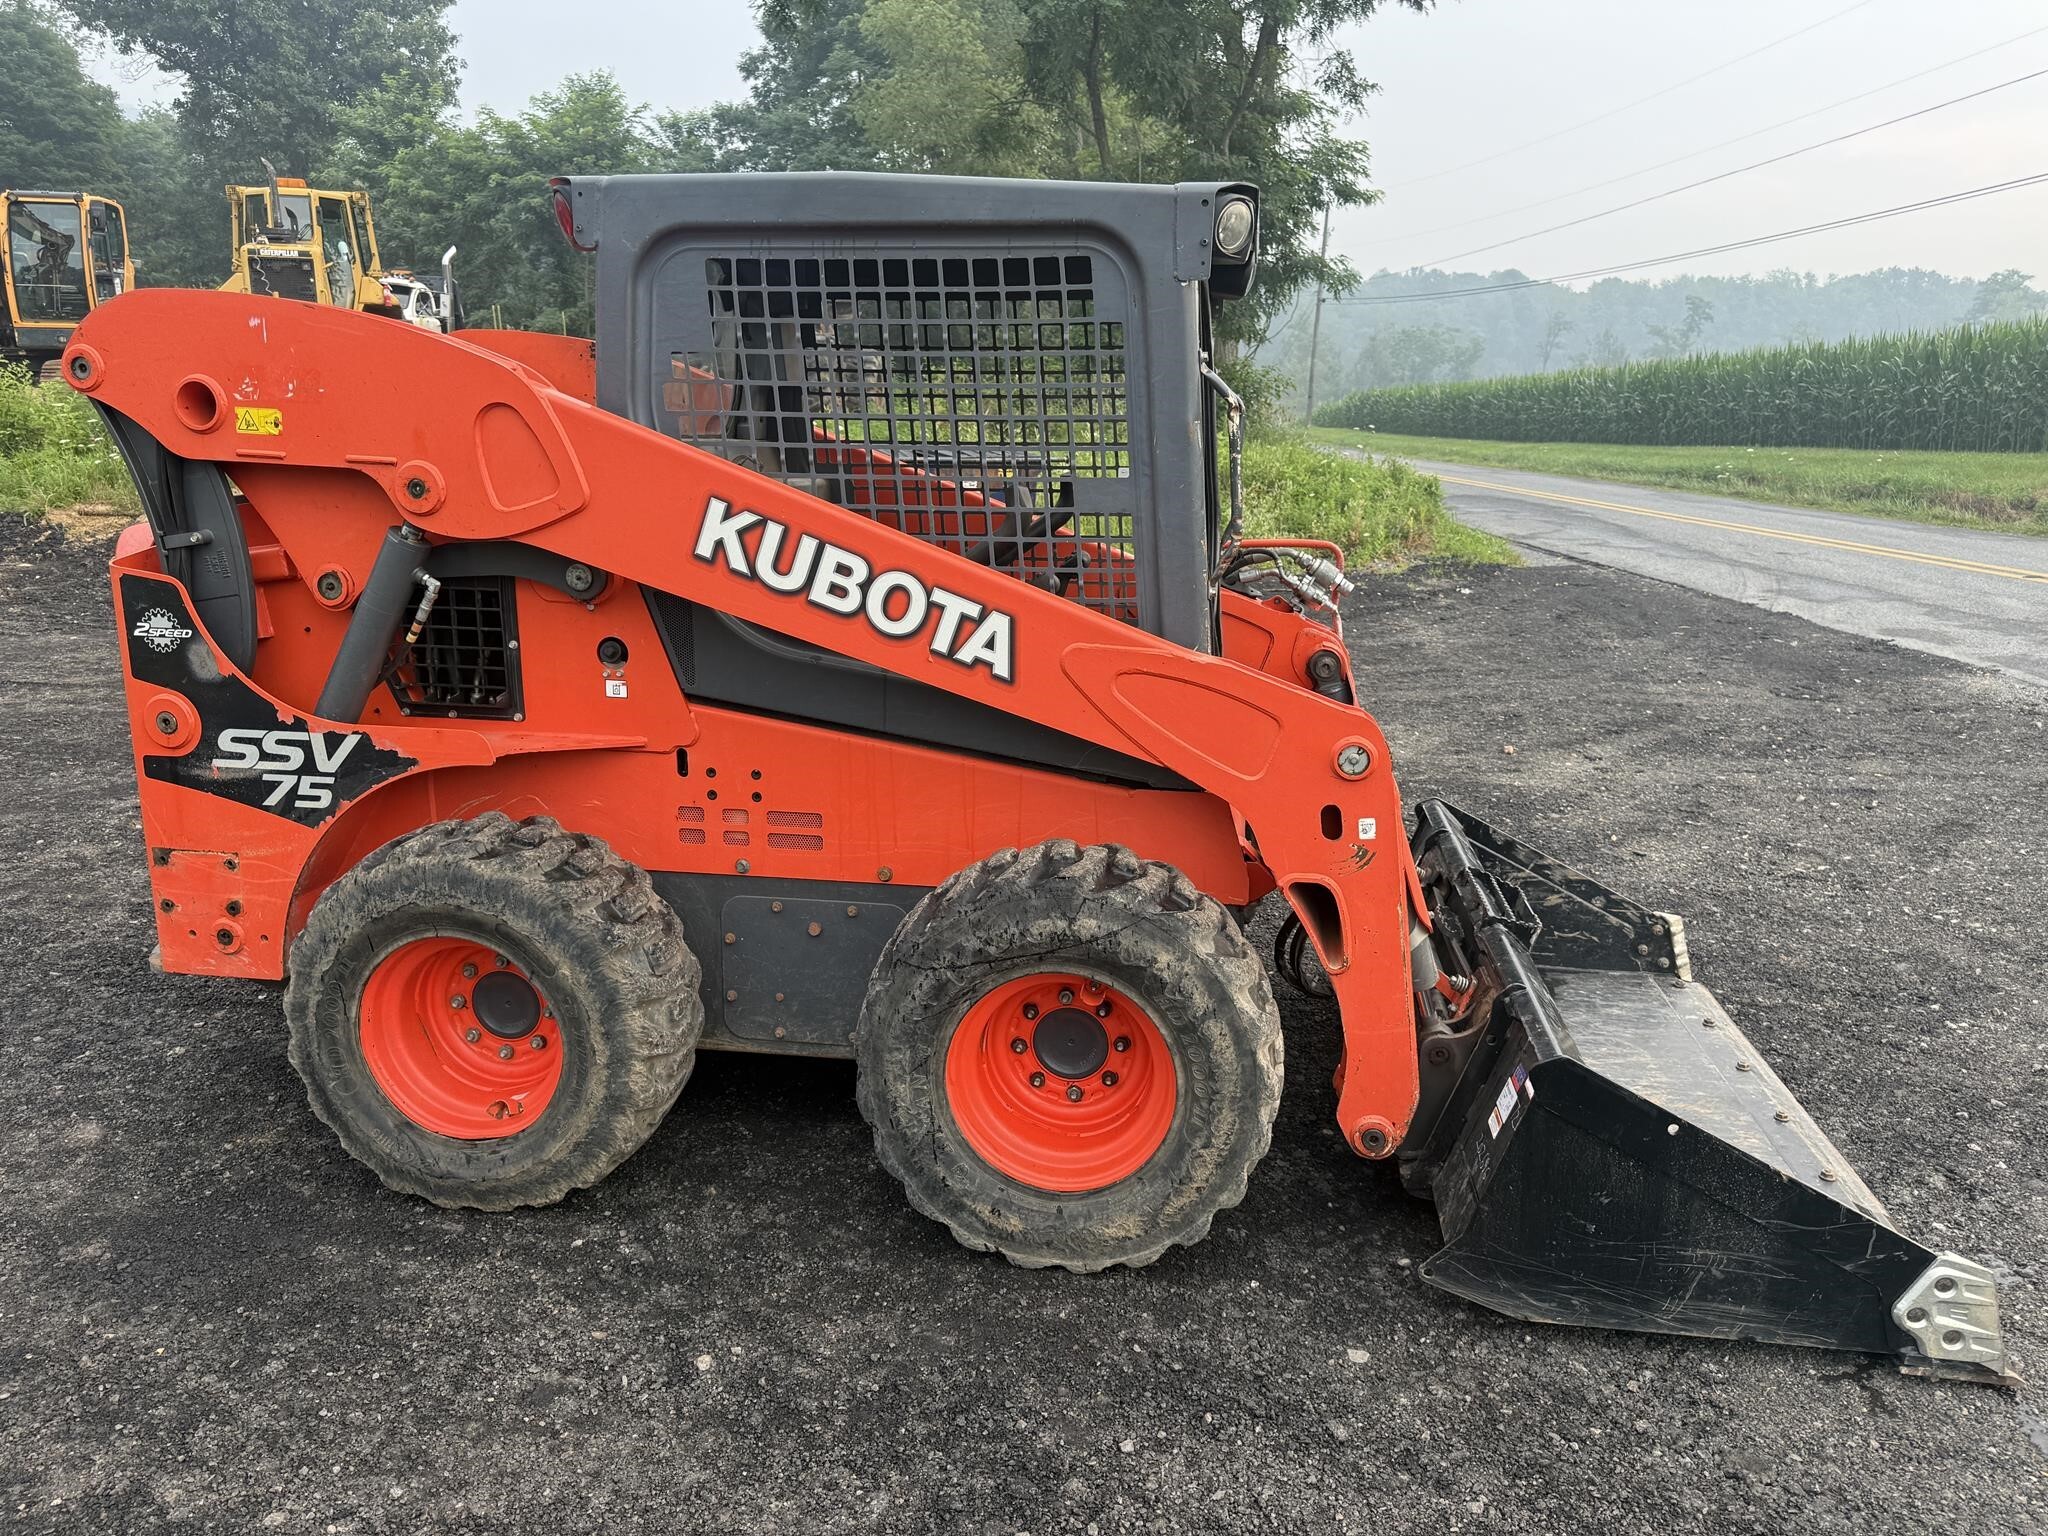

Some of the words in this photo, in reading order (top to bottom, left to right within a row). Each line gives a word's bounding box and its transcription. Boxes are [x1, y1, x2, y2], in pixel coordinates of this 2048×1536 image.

[694, 496, 1013, 682] KUBOTA
[211, 728, 362, 773] SSV
[262, 773, 335, 808] 75
